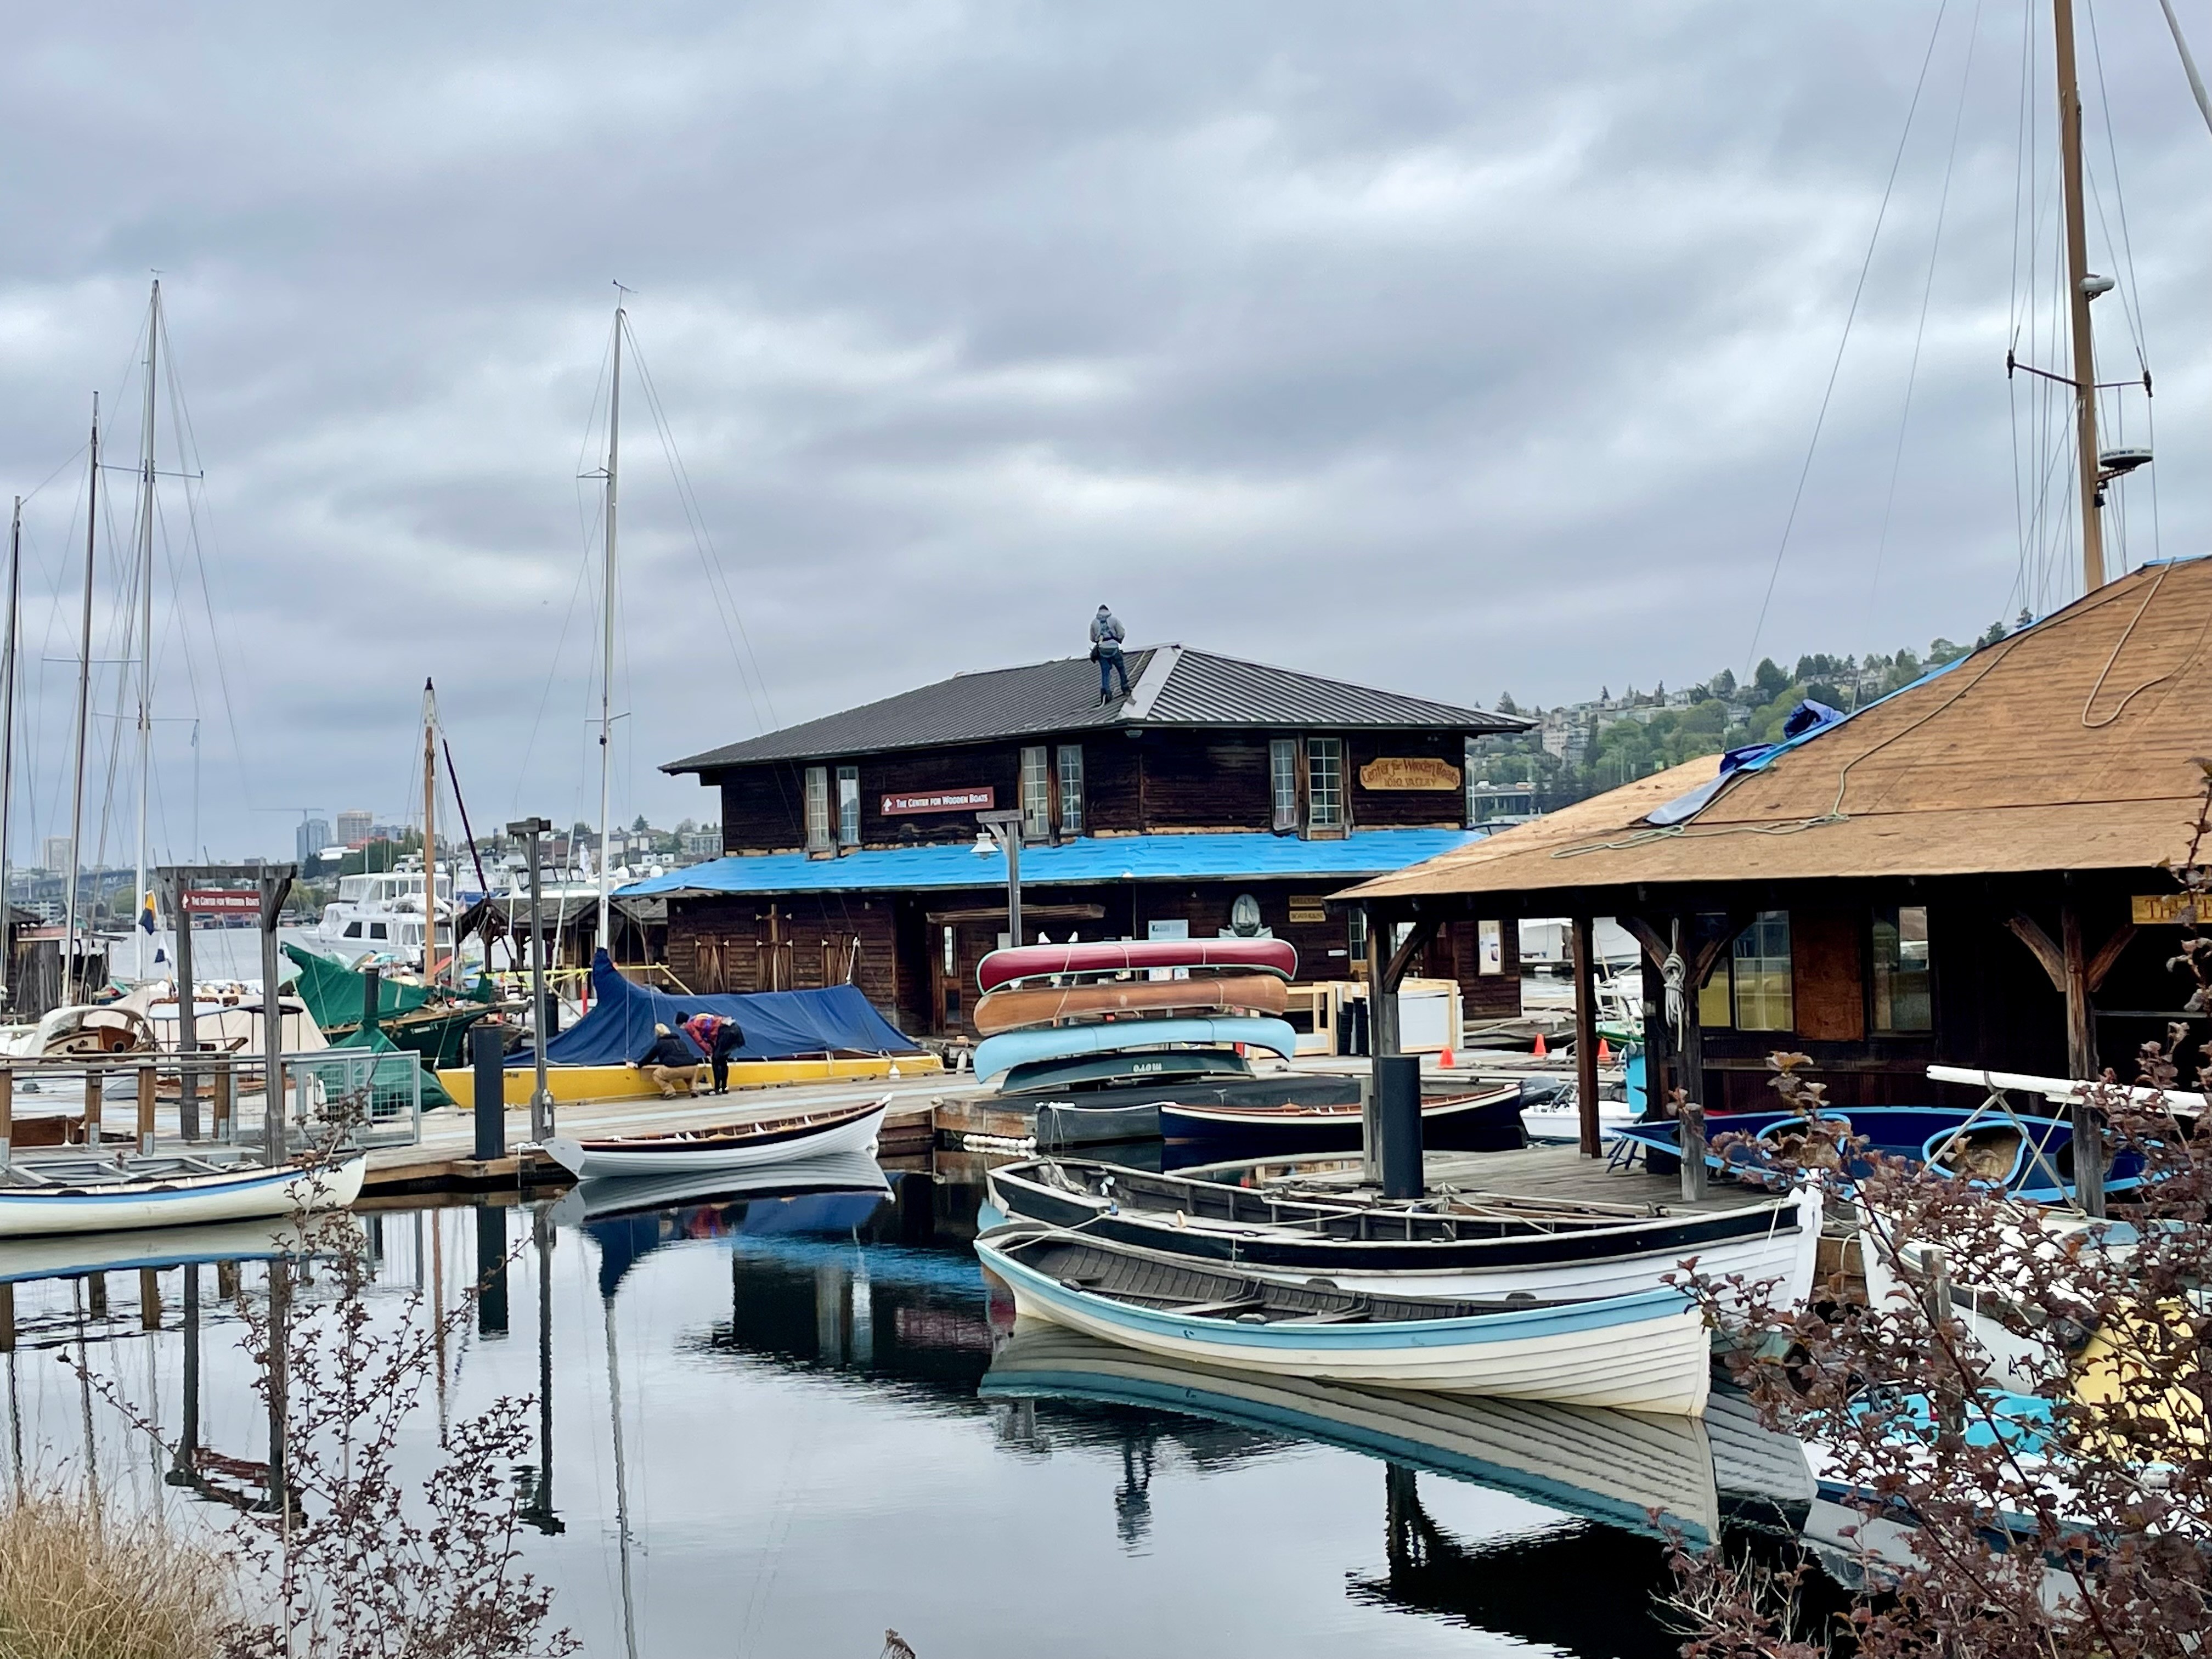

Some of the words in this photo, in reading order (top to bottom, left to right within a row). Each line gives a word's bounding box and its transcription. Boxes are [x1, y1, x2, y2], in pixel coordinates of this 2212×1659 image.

[1362, 763, 1389, 783] Center
[1389, 759, 1402, 777] for
[1403, 759, 1436, 776] Wooden
[1437, 762, 1459, 785] Boats
